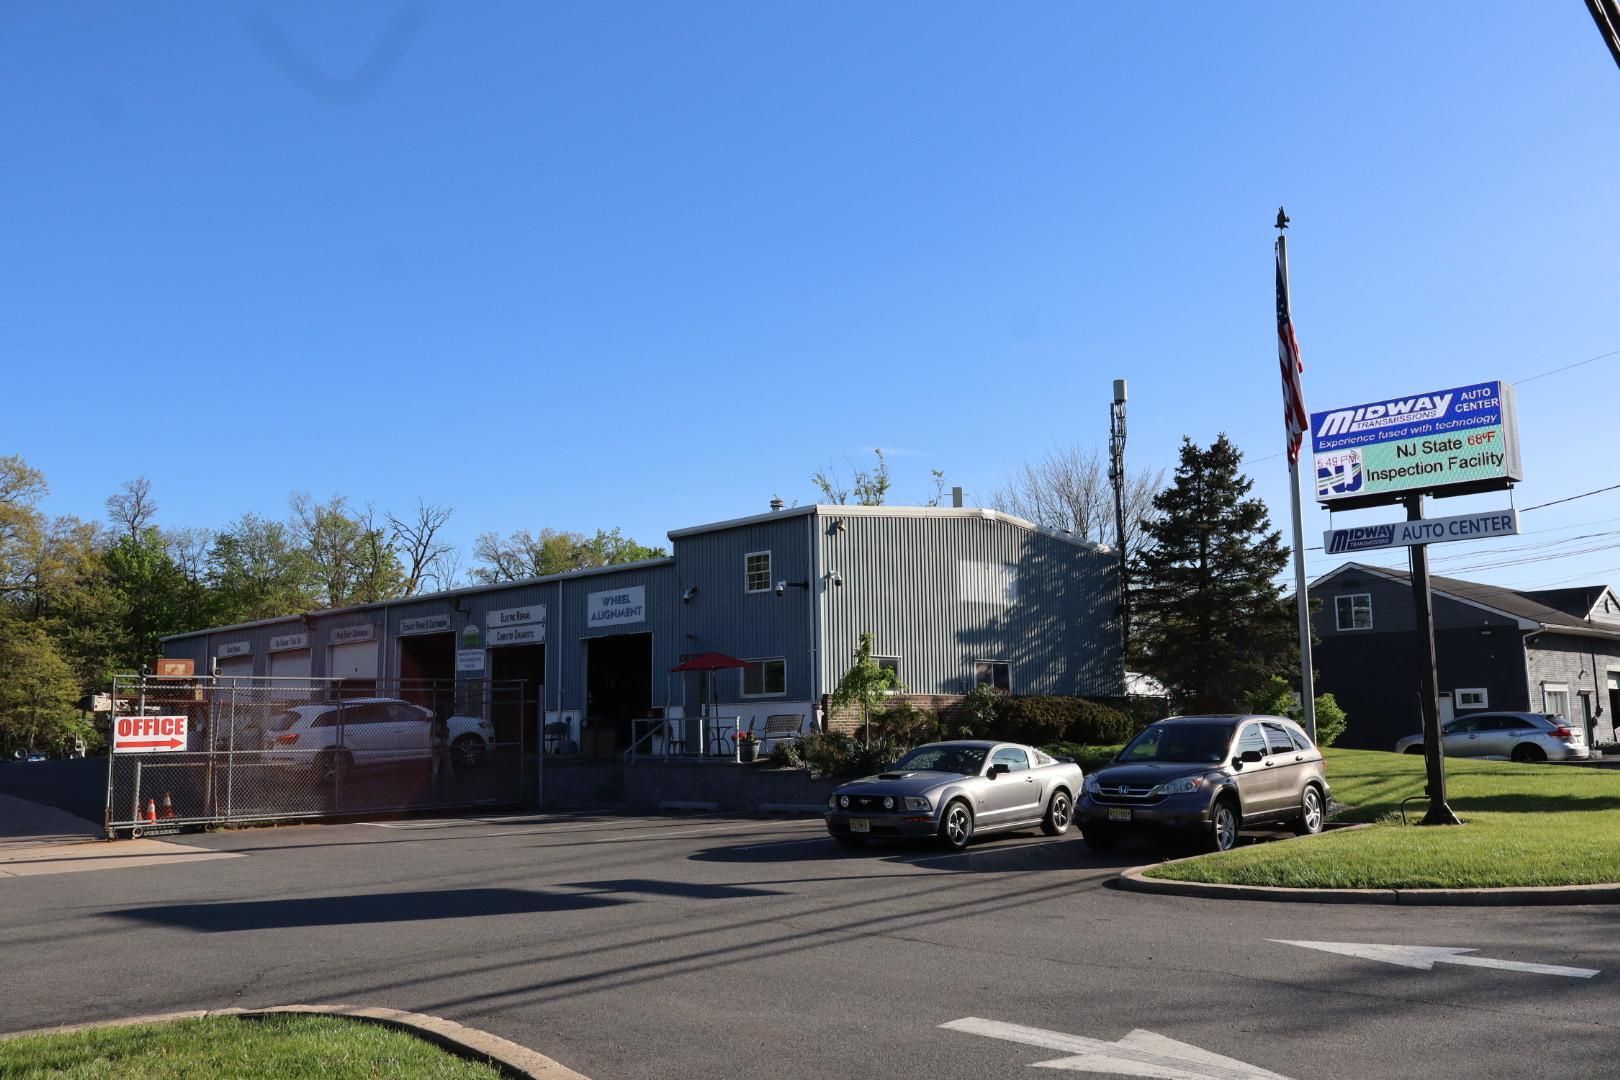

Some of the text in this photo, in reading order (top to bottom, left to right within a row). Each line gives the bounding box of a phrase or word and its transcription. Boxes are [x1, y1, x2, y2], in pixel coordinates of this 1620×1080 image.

[1460, 387, 1491, 401] AUTO
[1317, 393, 1453, 437] MIDWAY
[1455, 398, 1499, 413] CENTER
[1356, 410, 1437, 430] TRANSMISSIONS
[1318, 414, 1498, 449] Experience fused with technology
[1396, 438, 1463, 458] NJ State
[1367, 452, 1504, 482] Inspection Facility
[1329, 524, 1396, 552] MIDWAY
[1402, 515, 1512, 541] AUTO CENTER
[602, 594, 631, 607] WHEEL
[591, 606, 643, 621] ALIGNMENT
[118, 718, 185, 737] OFFICE
